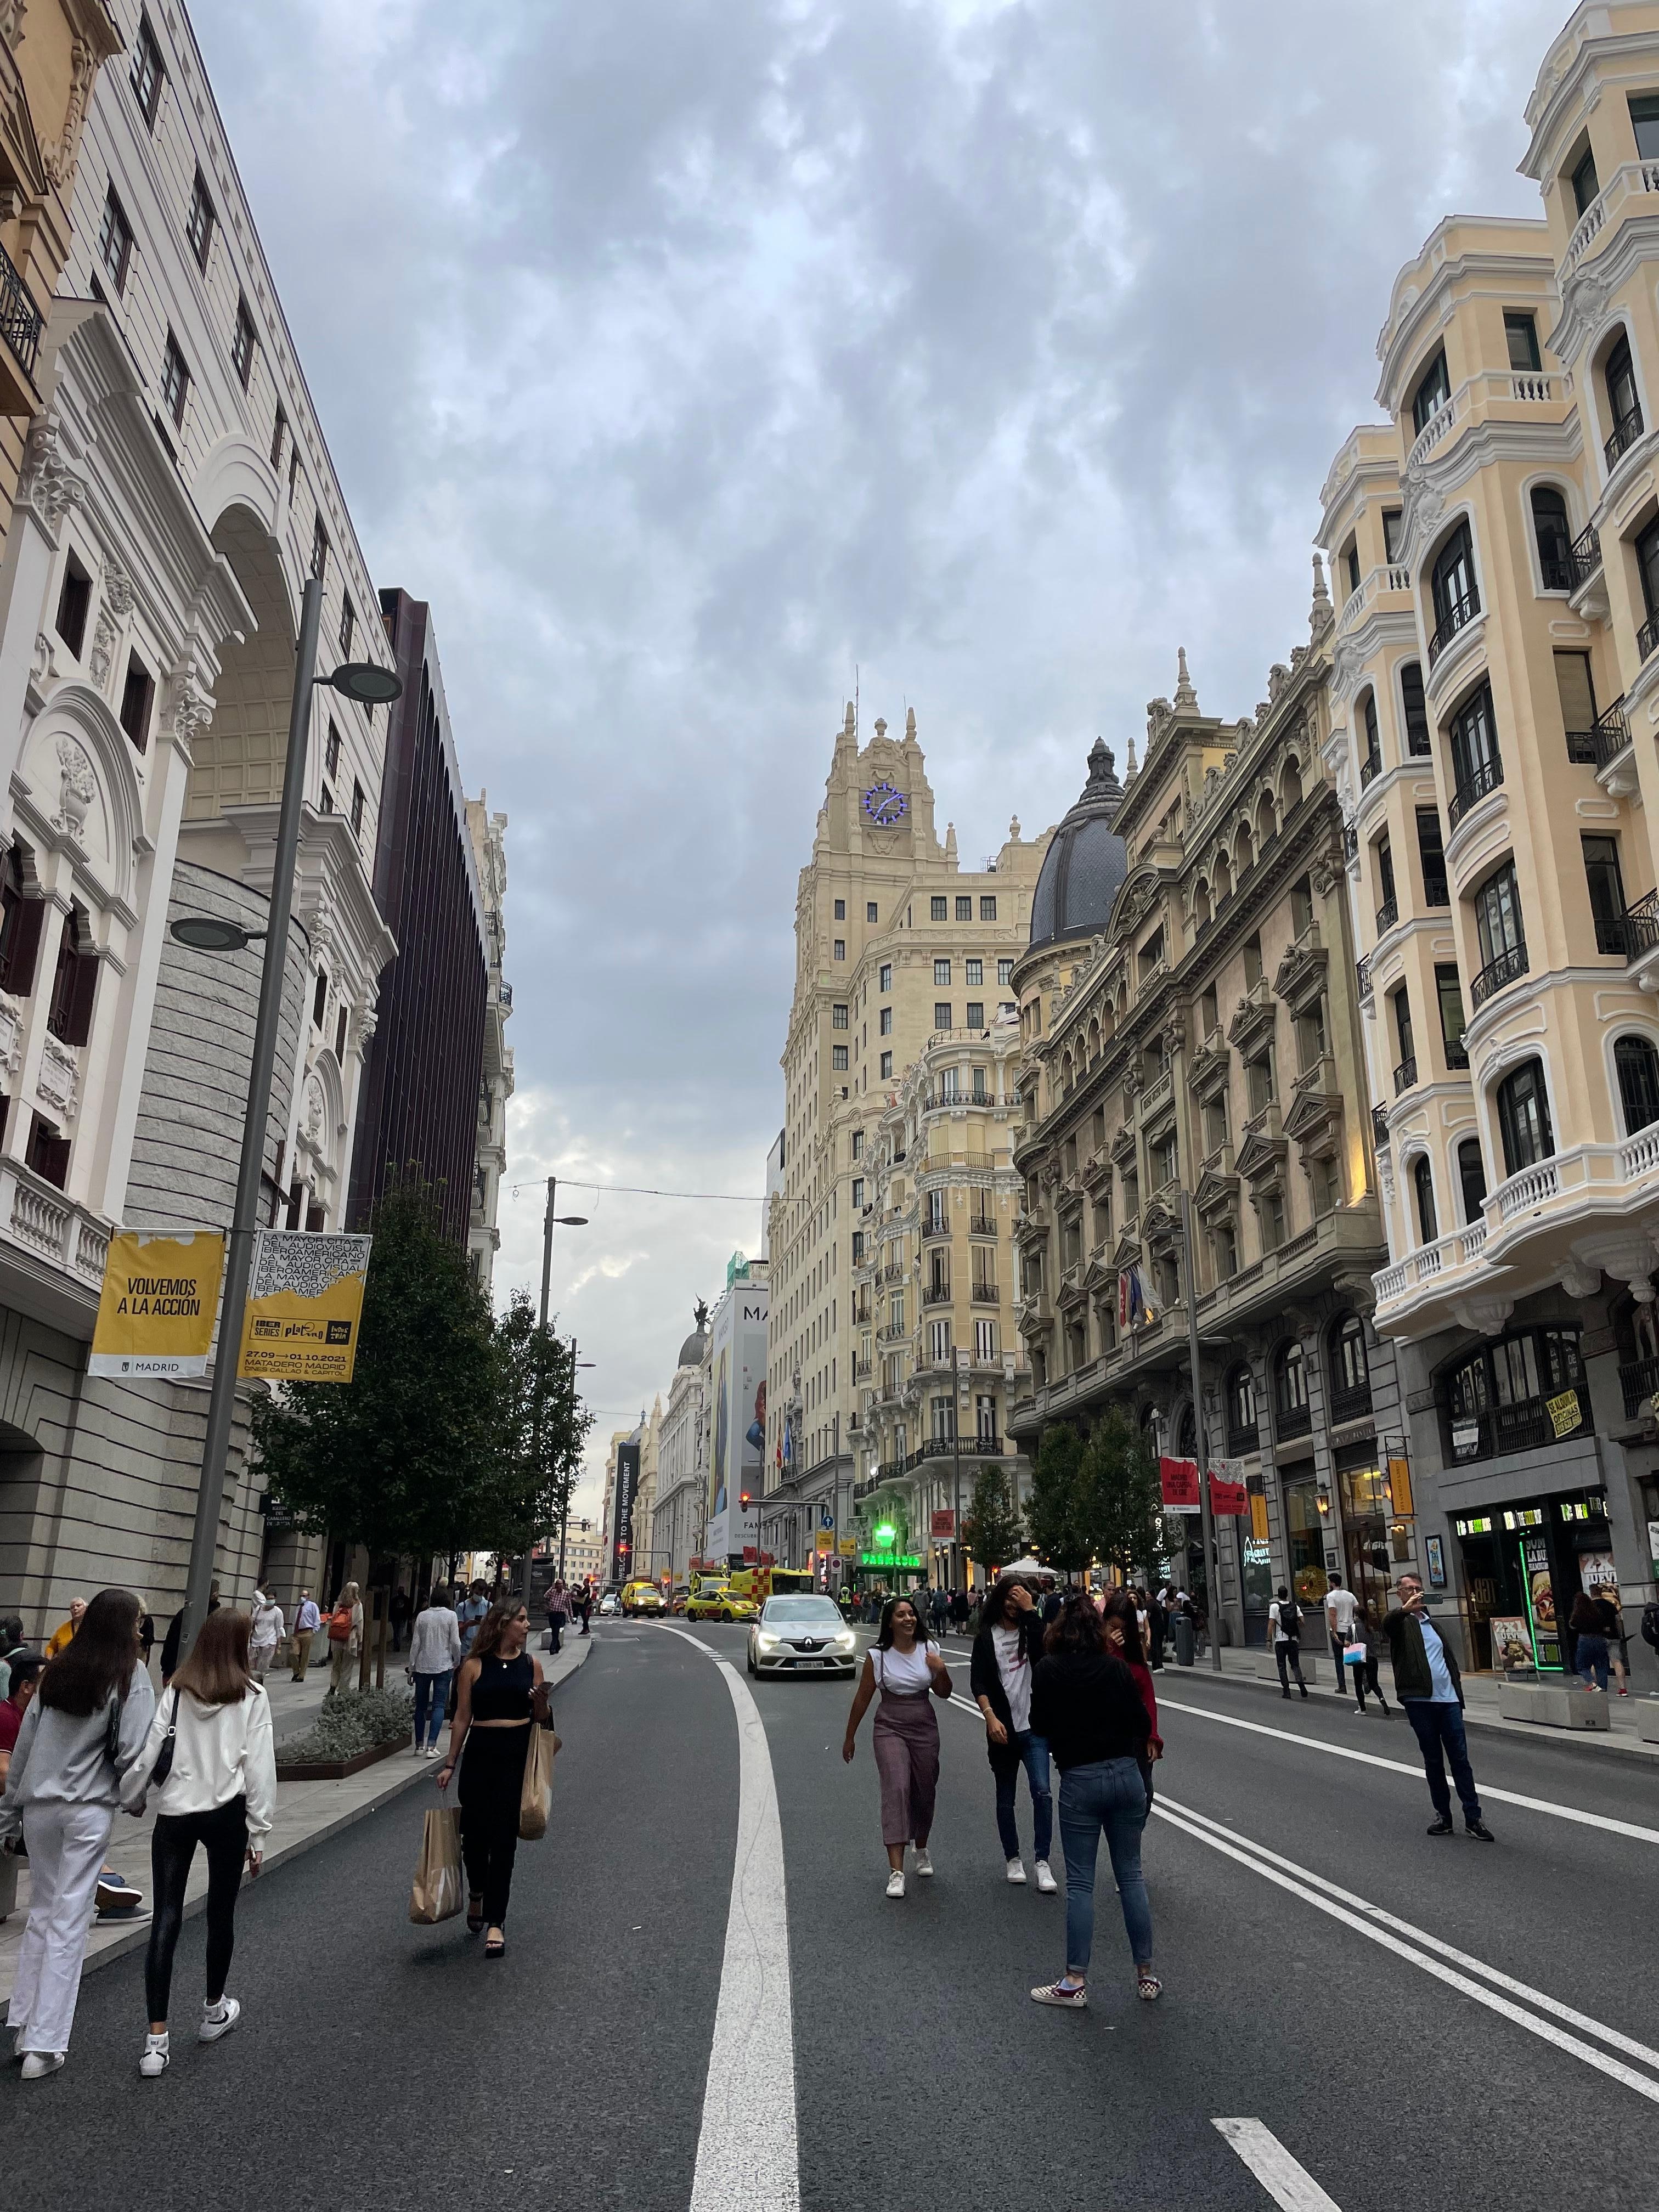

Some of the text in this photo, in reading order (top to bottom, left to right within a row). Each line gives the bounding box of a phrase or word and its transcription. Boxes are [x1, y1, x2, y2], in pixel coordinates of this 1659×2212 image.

[283, 1235, 323, 1244] MAYOR
[261, 1246, 365, 1259] IBEROAMERICANO
[289, 1243, 365, 1252] AUDIOVISUAL
[280, 1254, 320, 1262] MAYOR
[286, 1261, 363, 1271] AUDIOVISUAL
[127, 1278, 197, 1296] VOLVEMOS
[117, 1294, 200, 1316] A LA ACCIÓN
[255, 1328, 280, 1336] SERIES
[290, 1353, 347, 1362] 01.10.2021
[136, 1363, 179, 1372] MADRID
[245, 1359, 302, 1368] MATADERO
[1554, 1404, 1578, 1423] OFICINAS
[622, 1462, 630, 1506] MOVEMENT
[1588, 1498, 1602, 1510] TGB
[620, 1526, 627, 1536] TO
